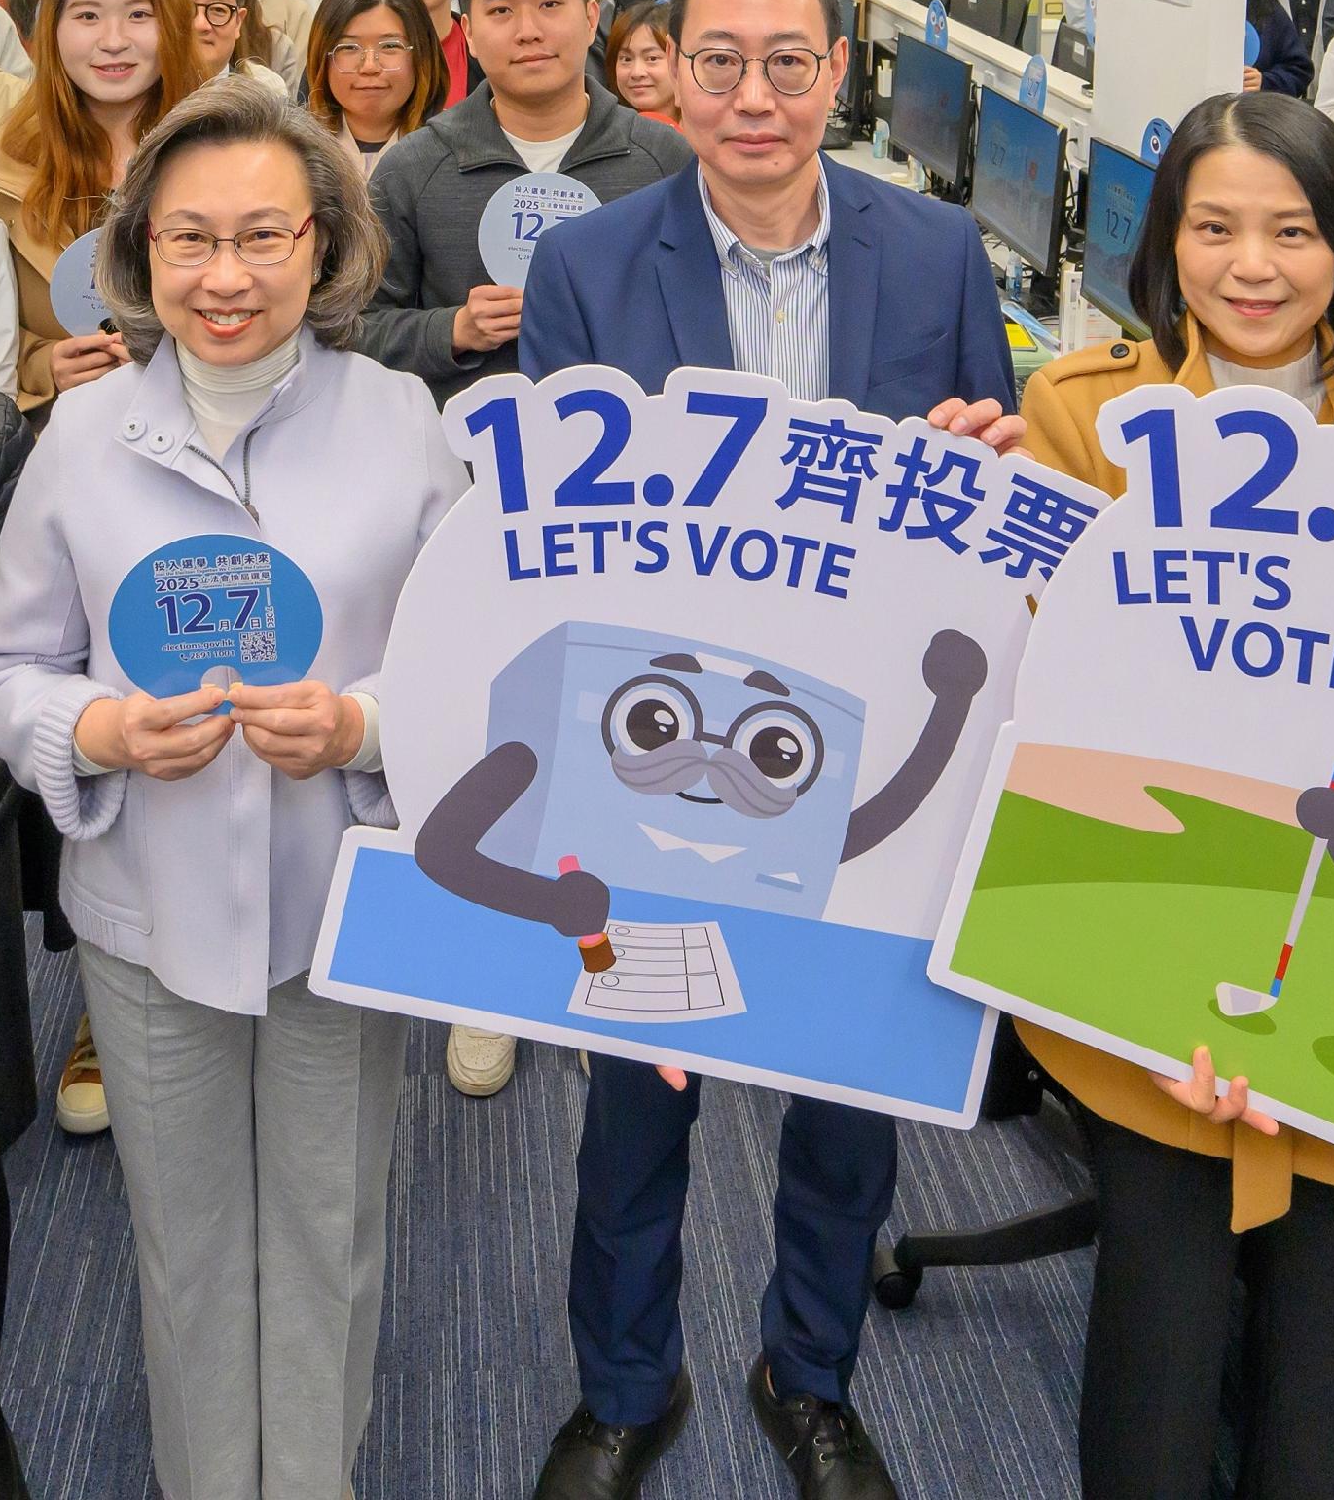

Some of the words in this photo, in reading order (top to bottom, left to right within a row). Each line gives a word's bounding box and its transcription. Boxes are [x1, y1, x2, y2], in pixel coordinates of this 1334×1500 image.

[515, 185, 547, 196] 投入選舉
[553, 189, 584, 200] 共創未來
[464, 389, 769, 515] 12.7
[774, 417, 1100, 585] 齊投票
[155, 557, 207, 572] 投入選舉
[216, 553, 270, 567] 共創未來
[503, 520, 669, 582] LET'S
[684, 522, 858, 601] VOTE
[1111, 549, 1292, 611] LET'S
[157, 589, 261, 635] 12月7日
